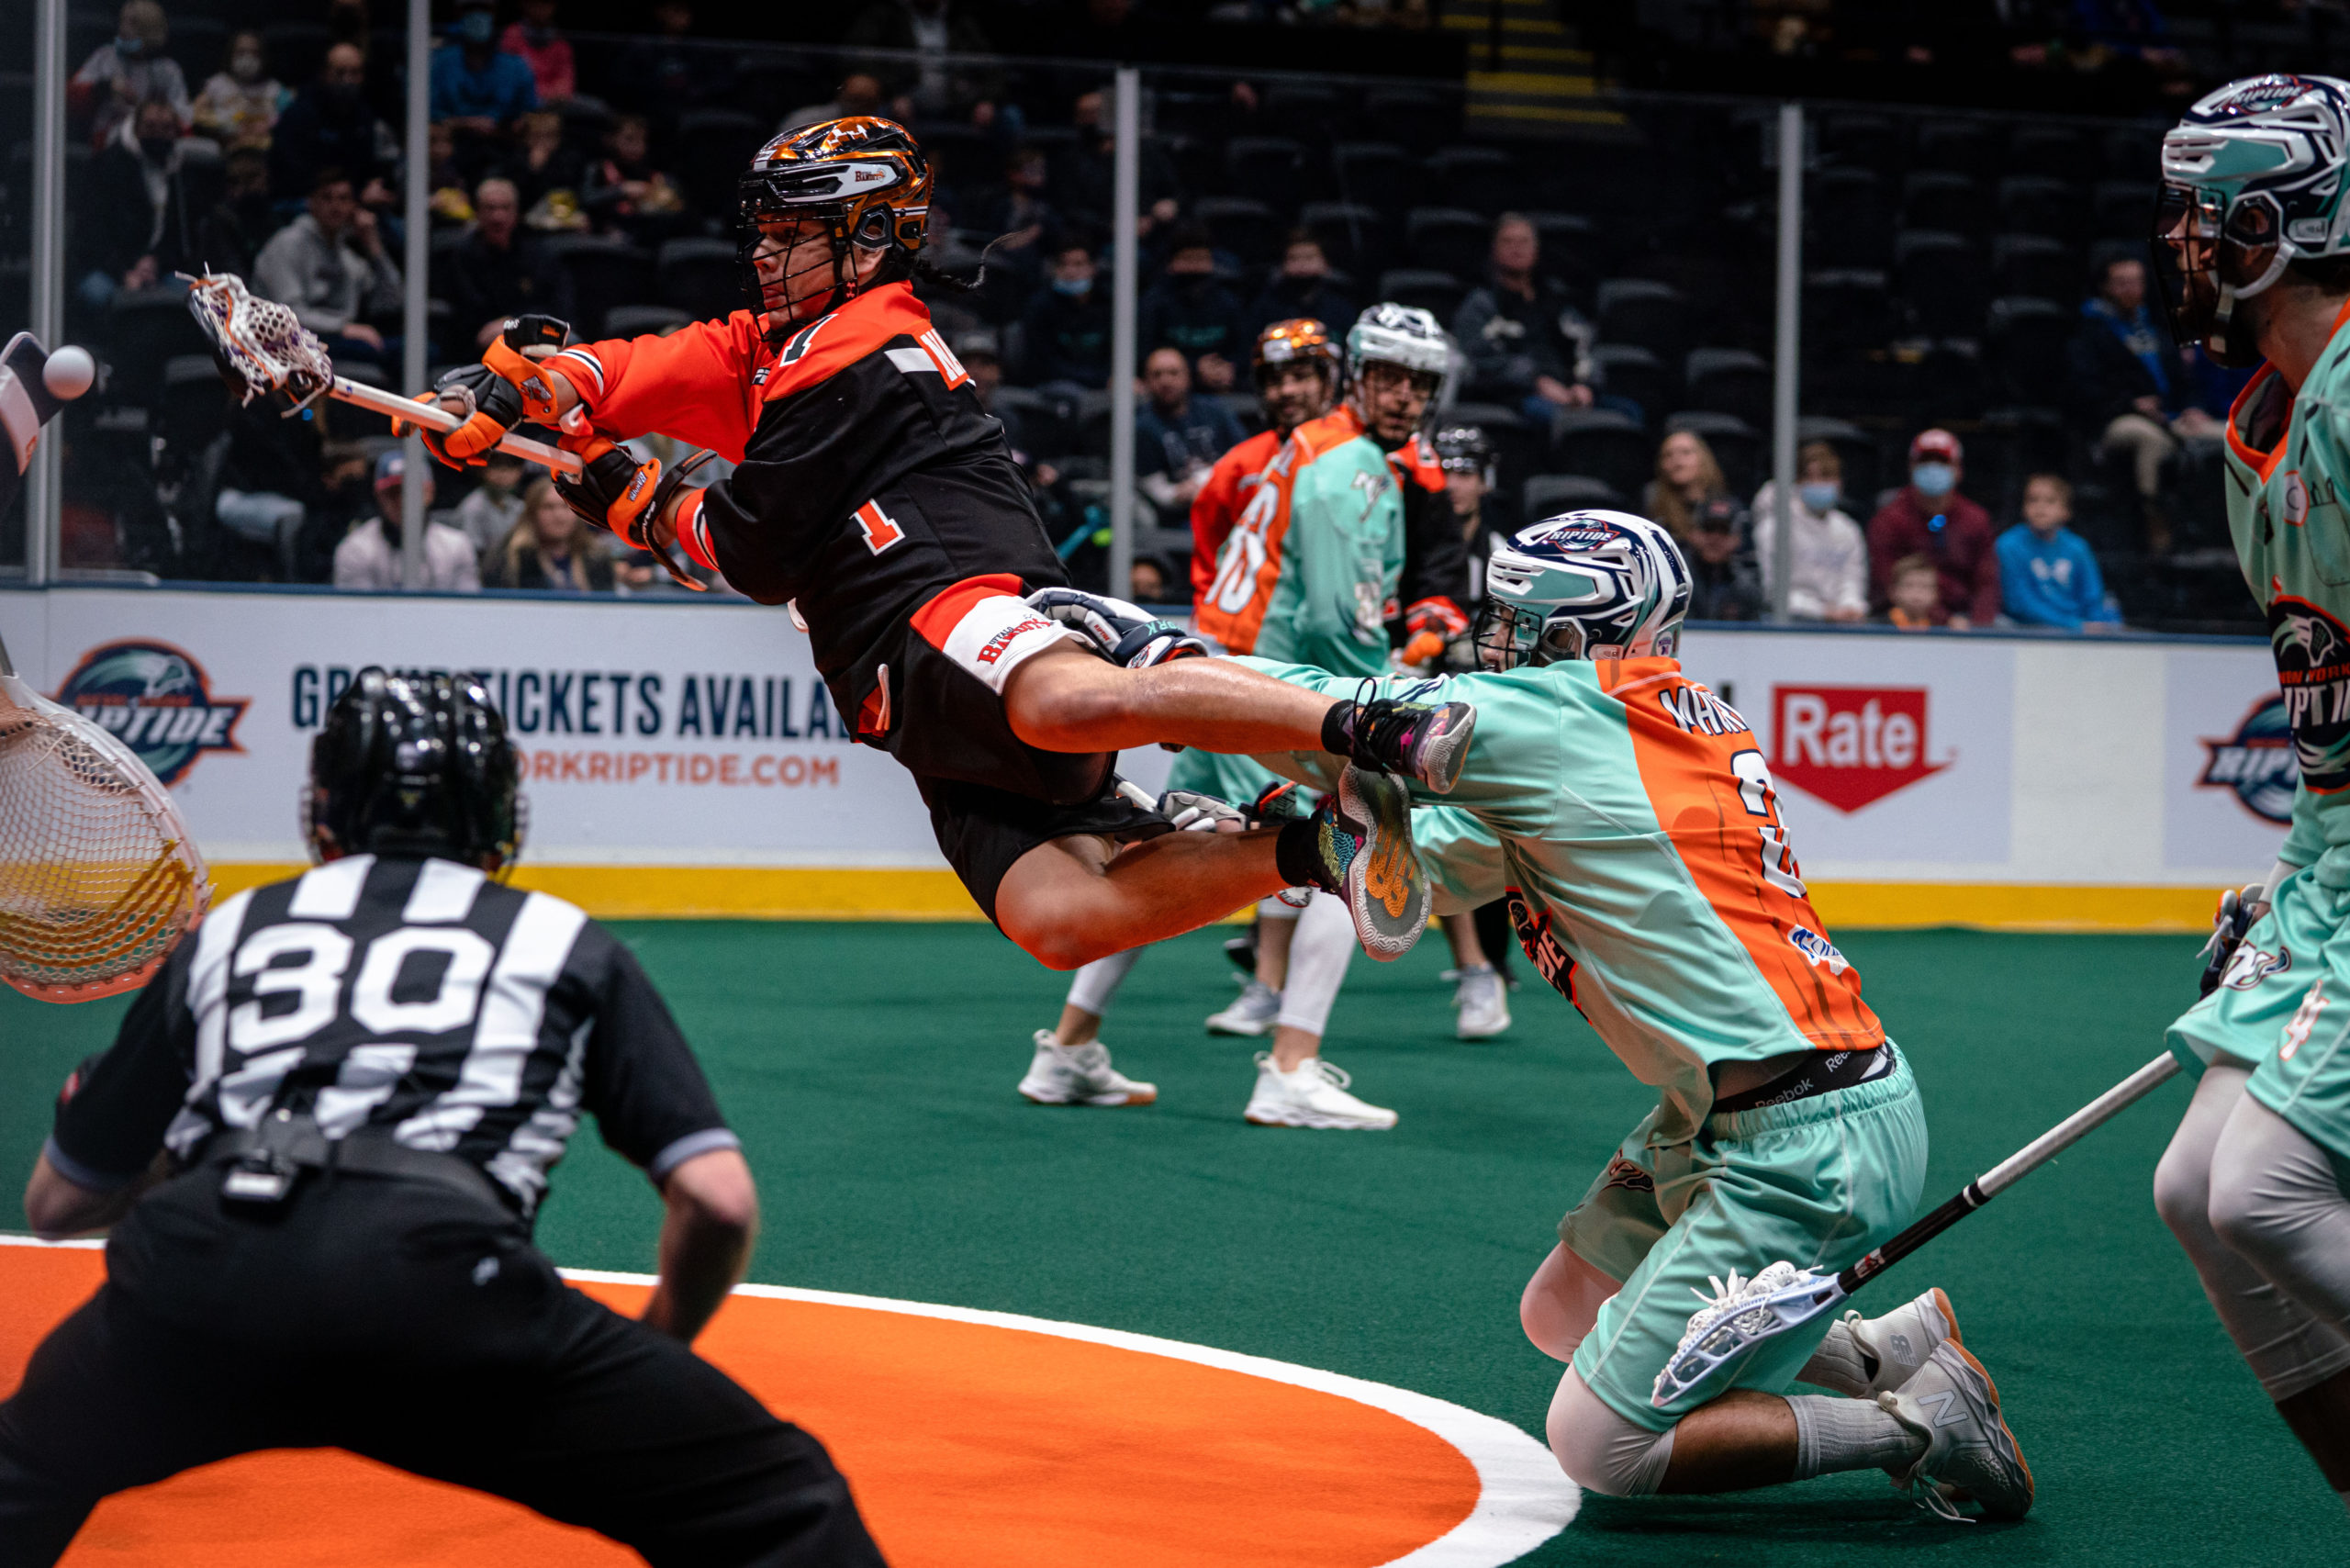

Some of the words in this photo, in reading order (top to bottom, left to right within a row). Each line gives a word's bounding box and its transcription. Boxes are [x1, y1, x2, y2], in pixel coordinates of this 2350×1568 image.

[1549, 530, 1614, 543] RIPTIDE
[471, 667, 664, 735] ICKETS
[677, 673, 850, 740] AVAILA
[1783, 693, 1918, 769] Rate
[229, 923, 495, 1054] 30
